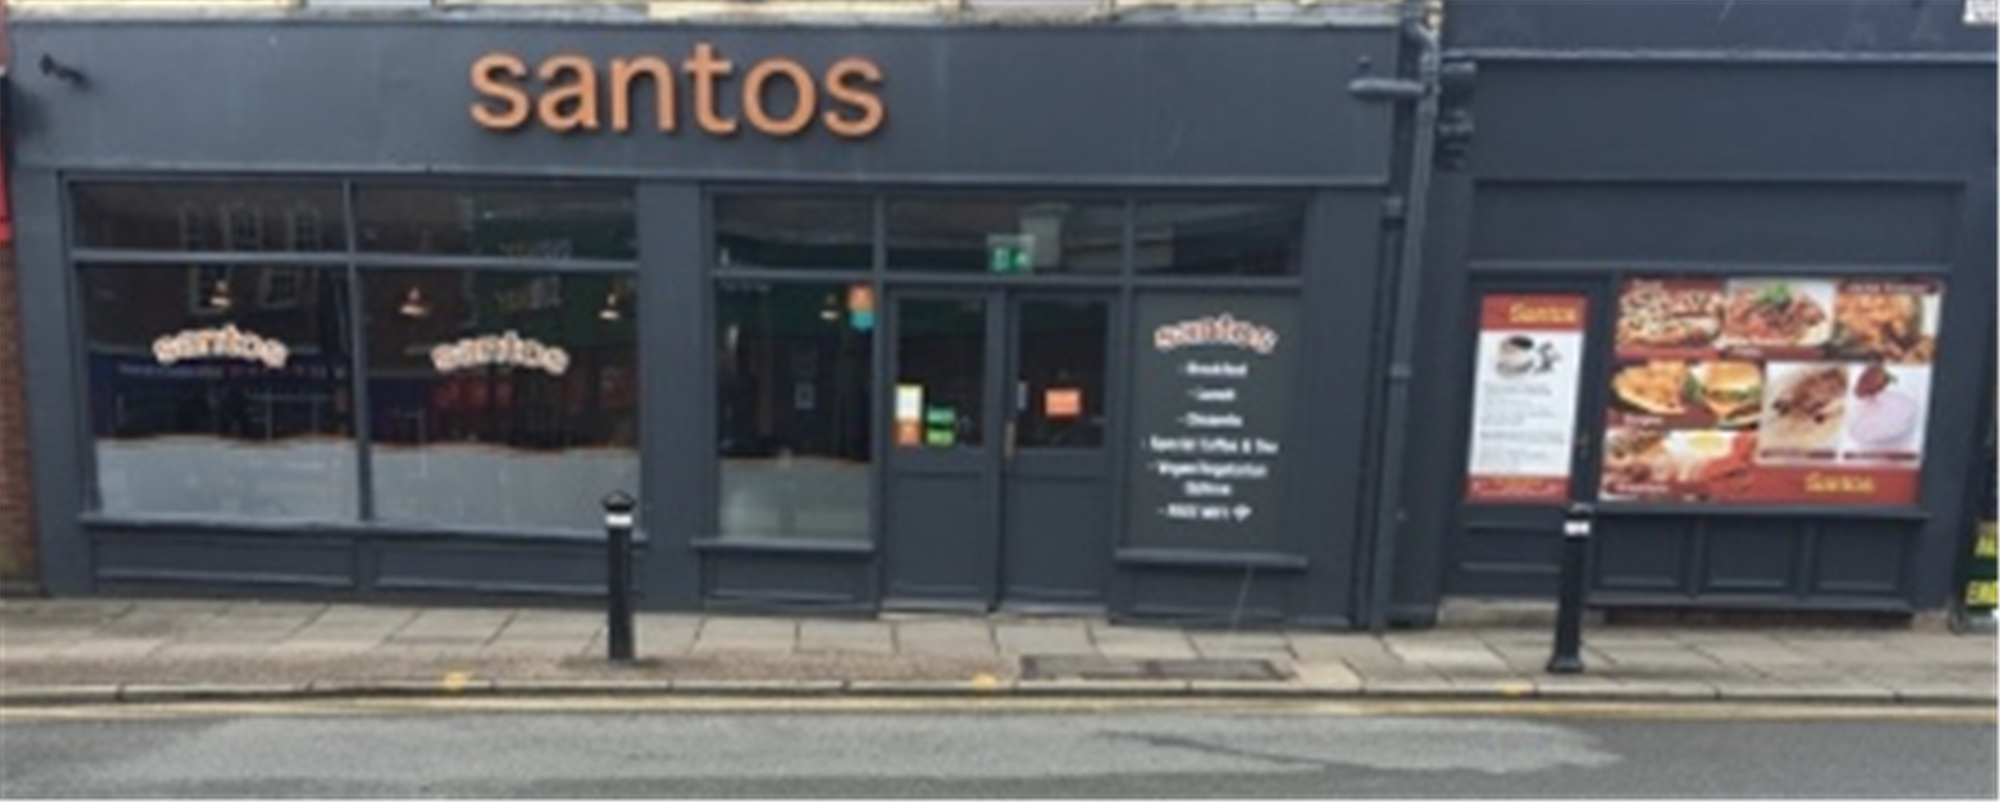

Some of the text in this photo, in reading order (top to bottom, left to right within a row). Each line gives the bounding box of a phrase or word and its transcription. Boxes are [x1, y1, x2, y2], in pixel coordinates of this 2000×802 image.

[469, 42, 885, 137] santos
[152, 323, 289, 368] santos
[431, 330, 570, 375] santos
[1153, 313, 1278, 354] santos
